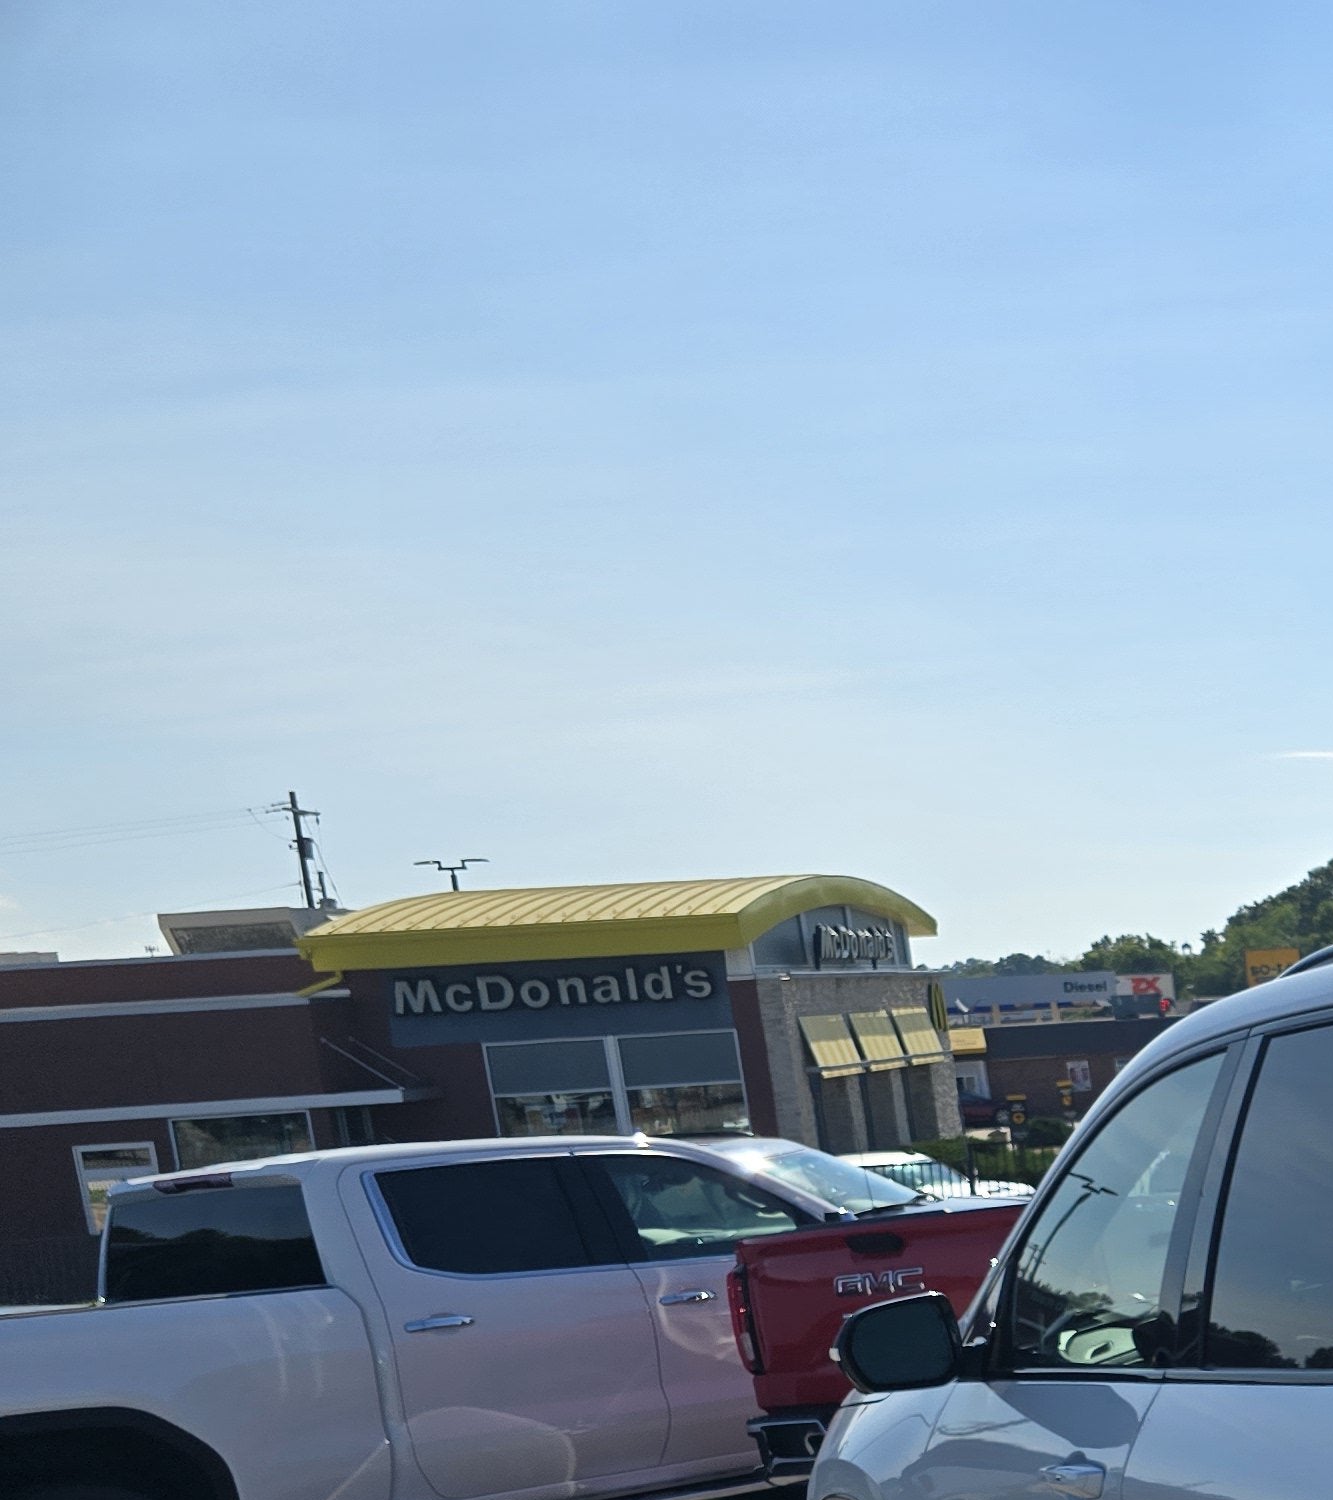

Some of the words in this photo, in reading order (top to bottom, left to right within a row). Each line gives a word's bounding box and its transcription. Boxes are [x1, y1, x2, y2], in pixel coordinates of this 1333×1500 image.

[393, 964, 713, 1015] McDonald's
[1063, 981, 1107, 993] Diesel
[833, 1267, 925, 1297] GMC
